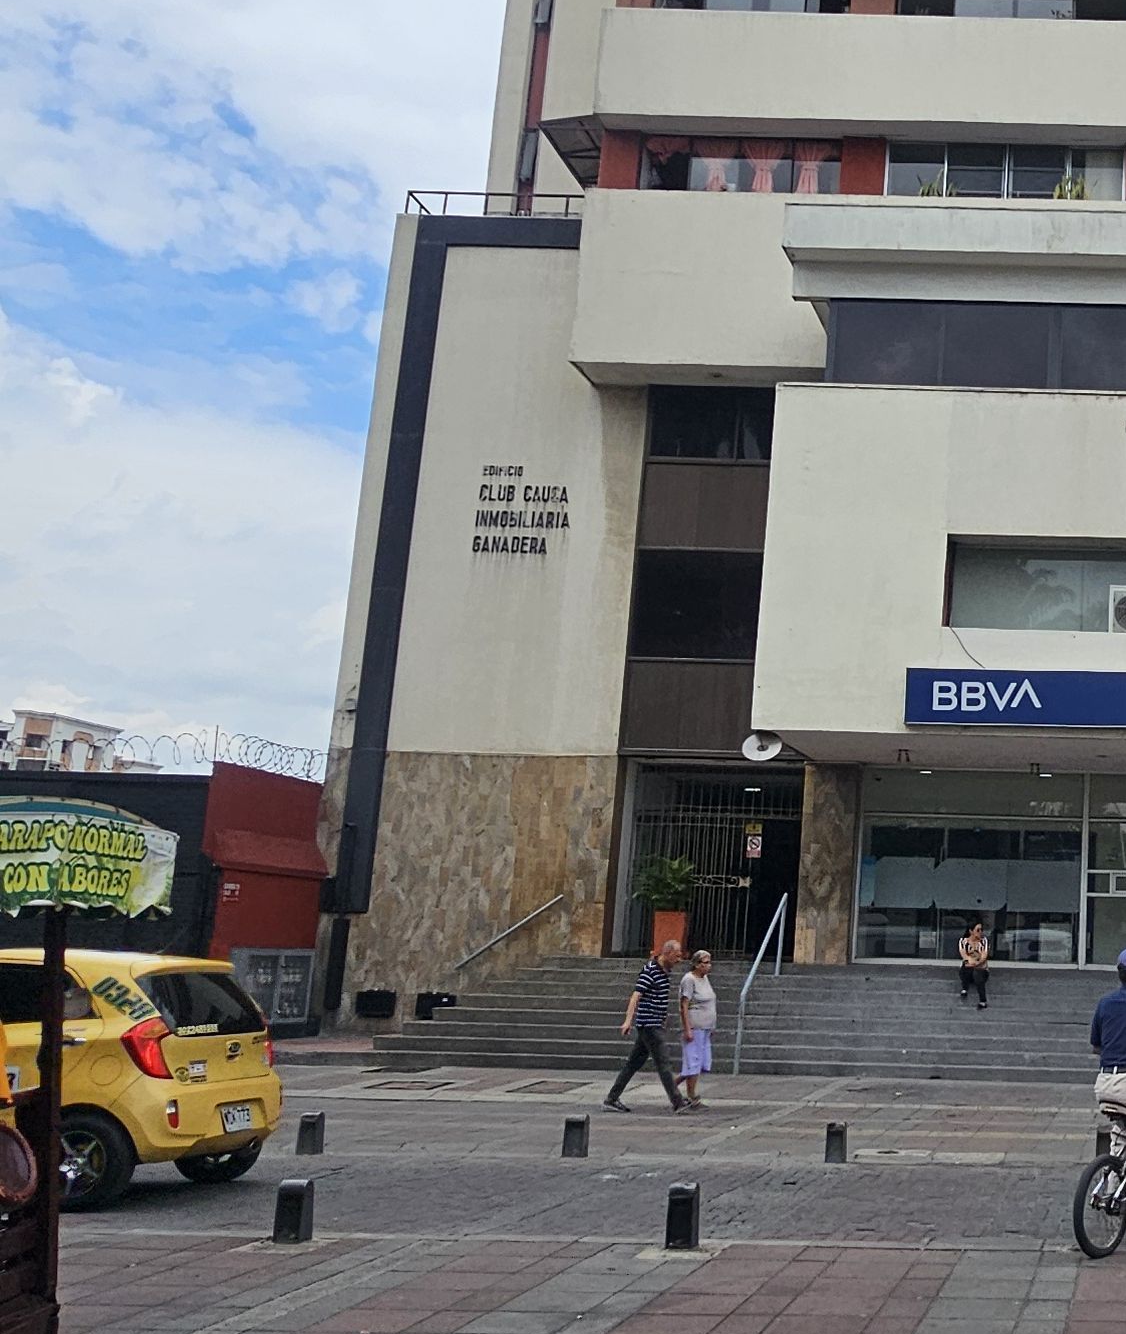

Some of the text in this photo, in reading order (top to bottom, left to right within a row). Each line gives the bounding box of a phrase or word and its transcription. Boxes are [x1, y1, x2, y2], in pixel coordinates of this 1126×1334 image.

[483, 466, 524, 477] EDIFICIO
[479, 484, 516, 502] CLUB
[472, 535, 547, 555] GANADERA
[931, 679, 1042, 711] BBVA
[69, 822, 148, 862] NORMAL
[3, 863, 51, 895] CON
